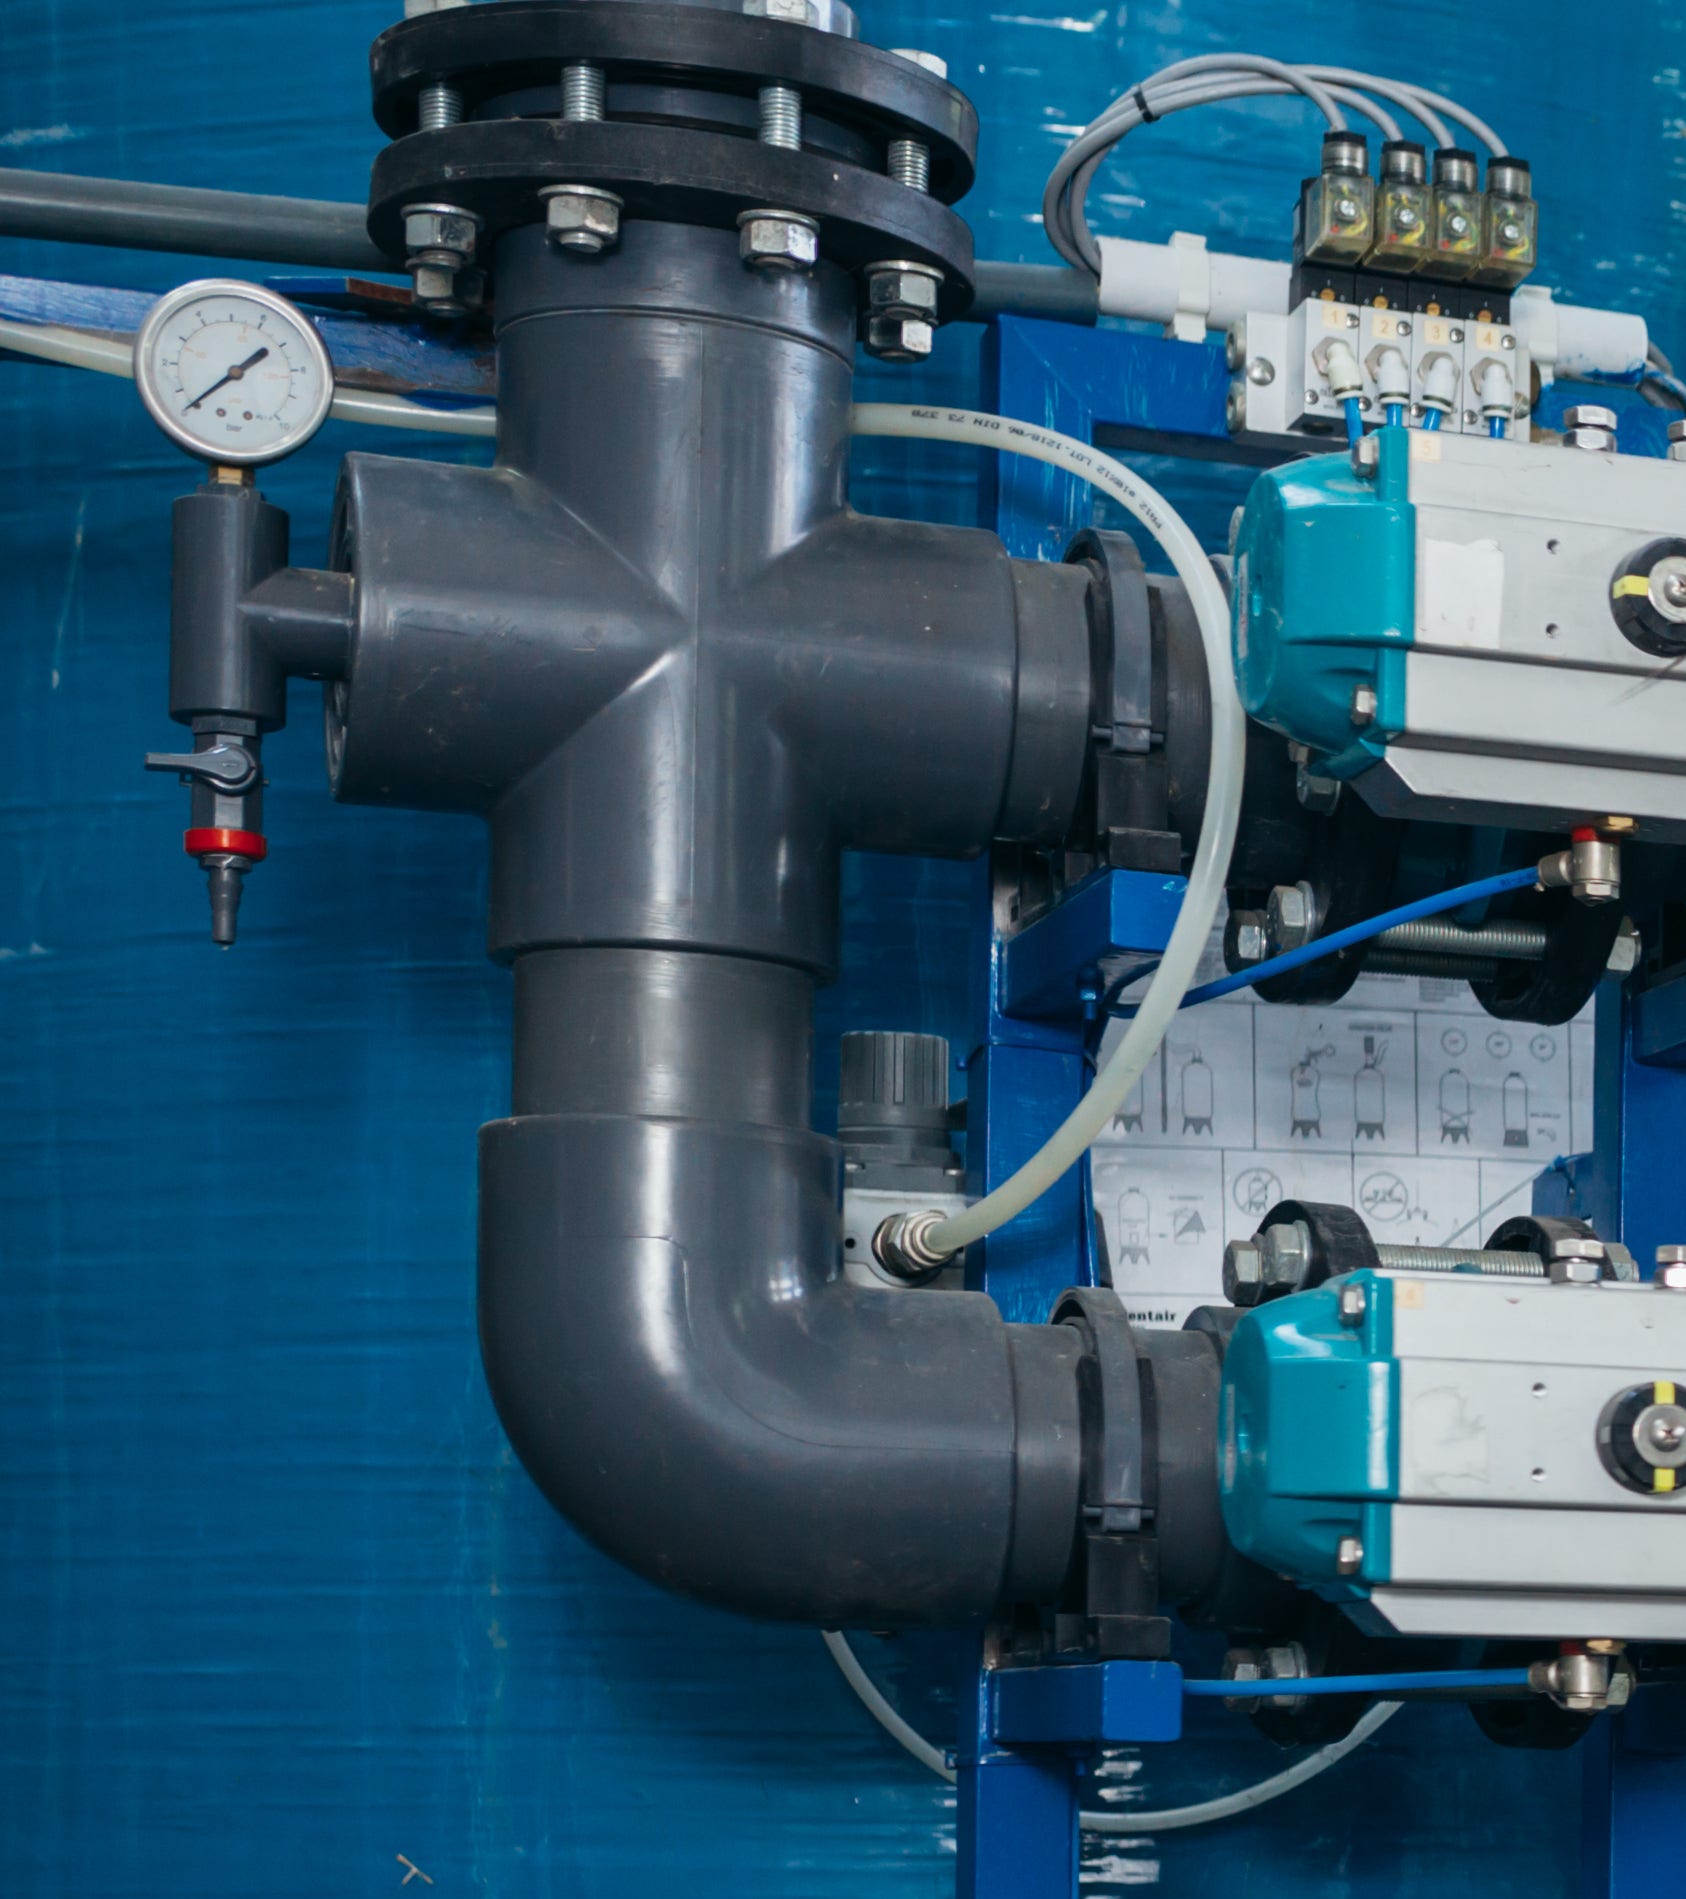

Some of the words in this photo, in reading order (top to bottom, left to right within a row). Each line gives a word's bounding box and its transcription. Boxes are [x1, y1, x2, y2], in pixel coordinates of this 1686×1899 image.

[1380, 319, 1389, 333] 2
[1431, 325, 1441, 340] 3
[1483, 332, 1493, 345] 4
[973, 417, 1001, 431] DIN
